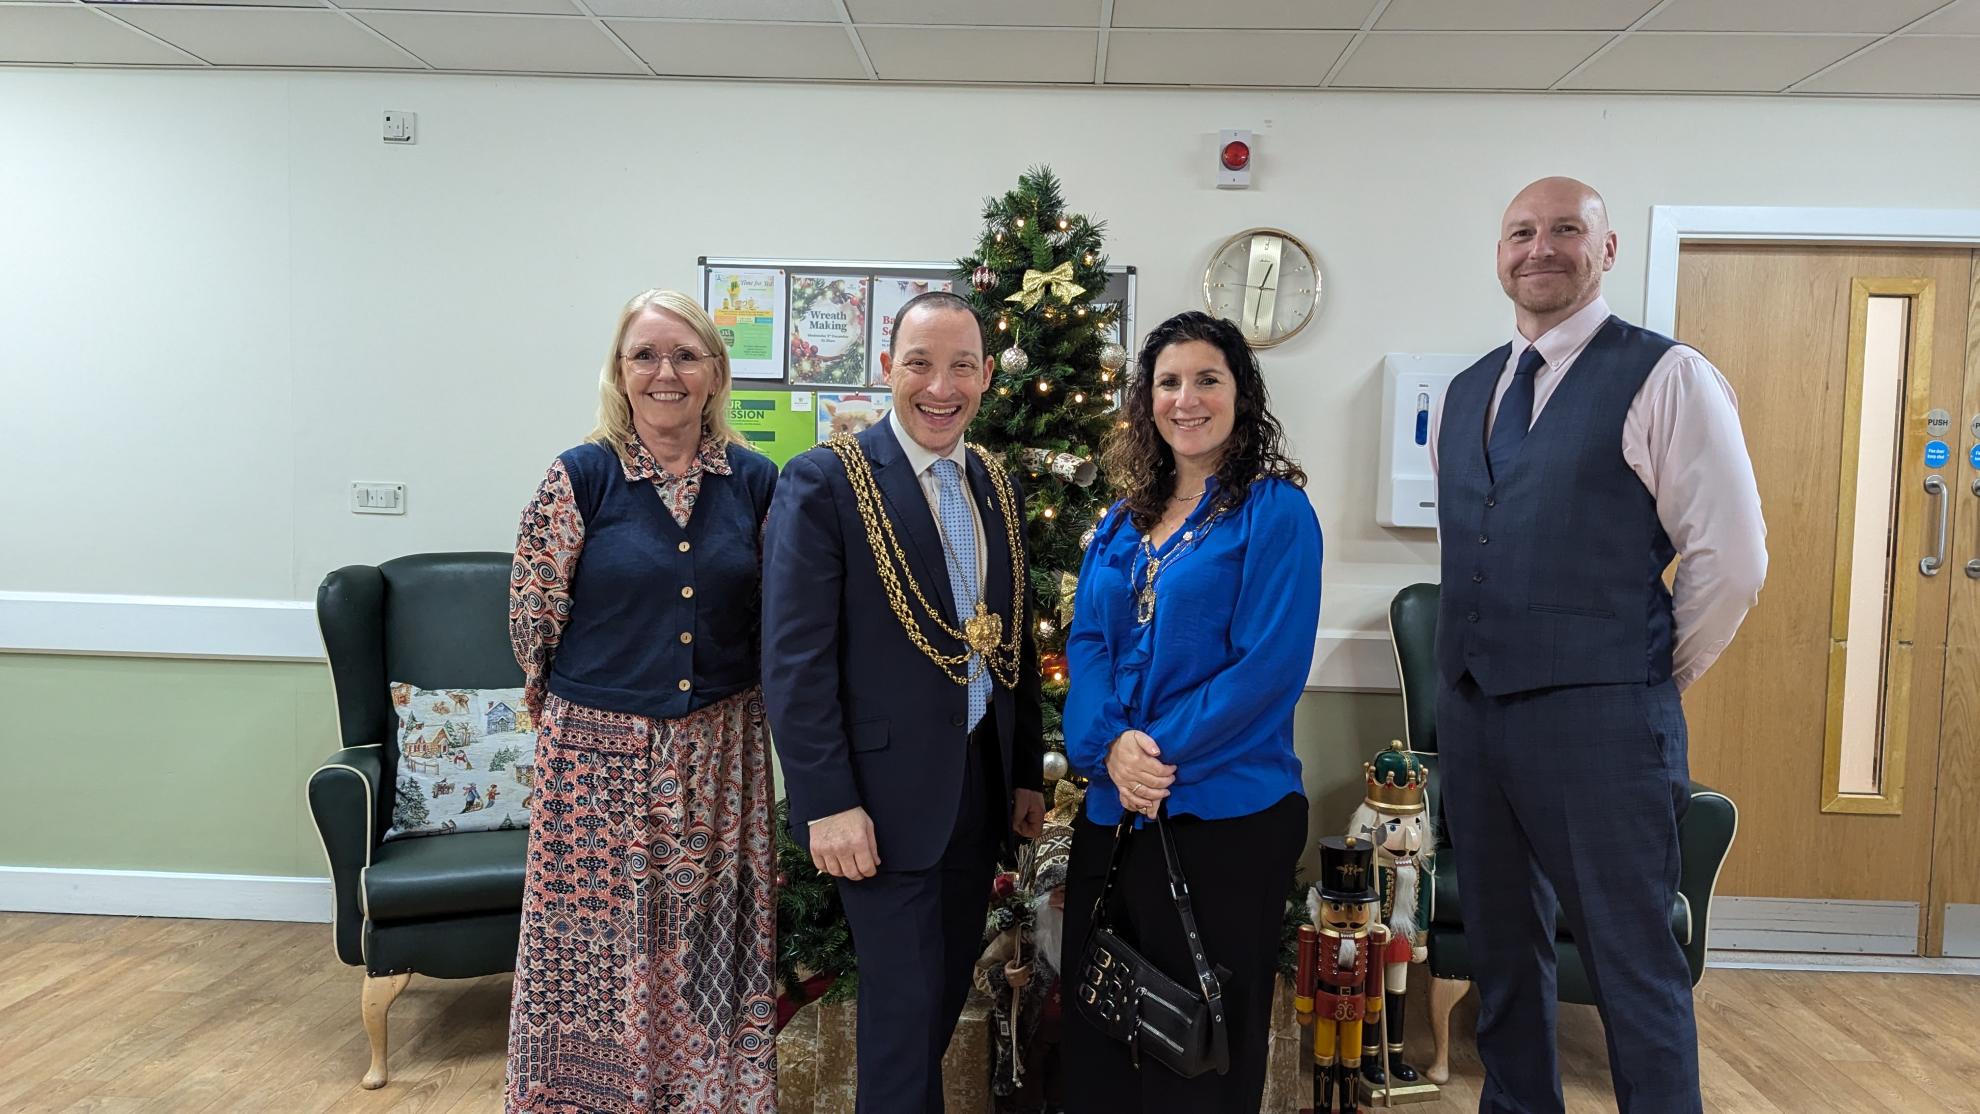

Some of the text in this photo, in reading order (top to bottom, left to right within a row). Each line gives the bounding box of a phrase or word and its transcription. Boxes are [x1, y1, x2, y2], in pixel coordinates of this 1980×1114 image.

[810, 310, 847, 320] Wreath
[809, 320, 847, 333] Making
[727, 400, 742, 410] UR
[727, 410, 765, 419] ISSION
[1927, 418, 1949, 427] PUSH
